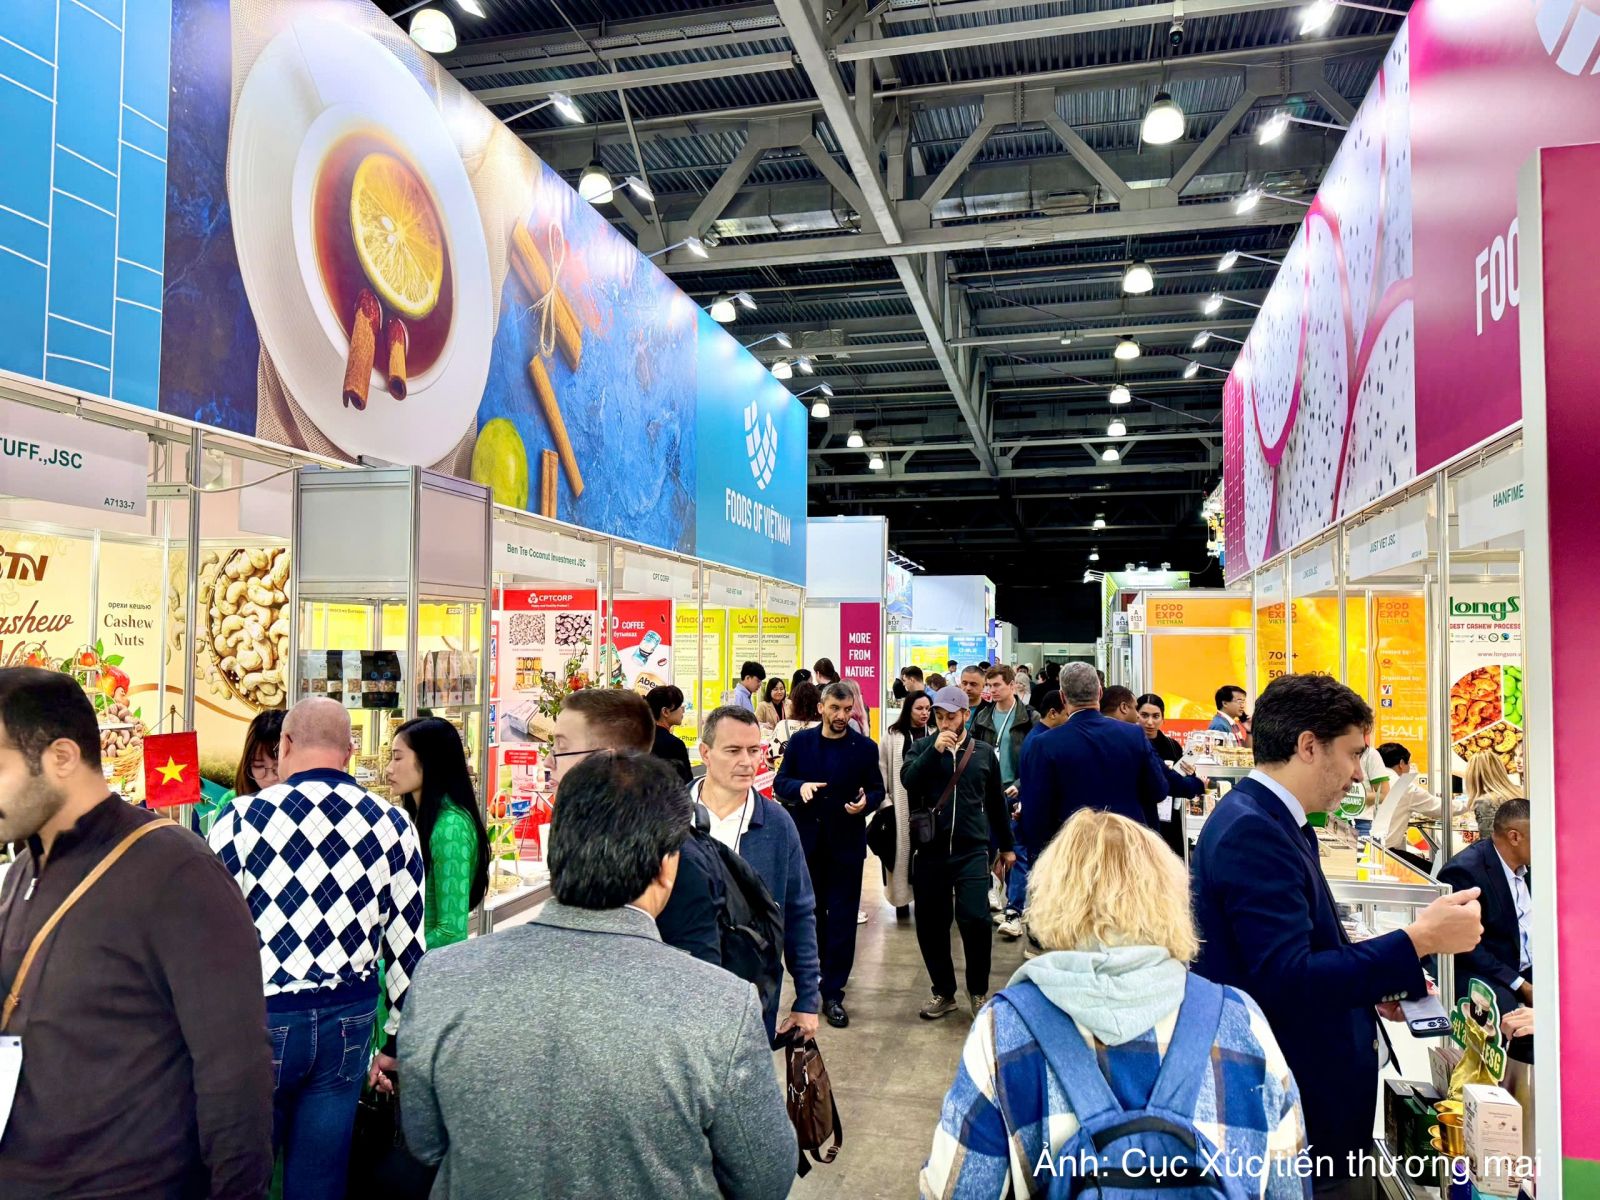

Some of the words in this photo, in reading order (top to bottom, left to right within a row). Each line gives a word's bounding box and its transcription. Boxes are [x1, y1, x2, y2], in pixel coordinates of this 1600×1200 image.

[104, 497, 135, 510] A7133-7
[725, 487, 752, 531] FOODS
[753, 501, 763, 534] OF
[506, 543, 519, 555] Ben
[519, 546, 528, 557] Tre
[528, 548, 551, 561] Coconut
[551, 553, 577, 566] Investment
[538, 594, 573, 602] CPTCORP
[108, 601, 128, 610] орехи
[129, 602, 152, 611] кешью
[1379, 602, 1409, 610] FOOD
[104, 613, 154, 629] Cashew
[621, 621, 645, 629] COFFEE
[114, 633, 145, 647] Nuts
[848, 633, 872, 644] MORE
[848, 650, 871, 661] FROM
[844, 666, 875, 678] NATURE
